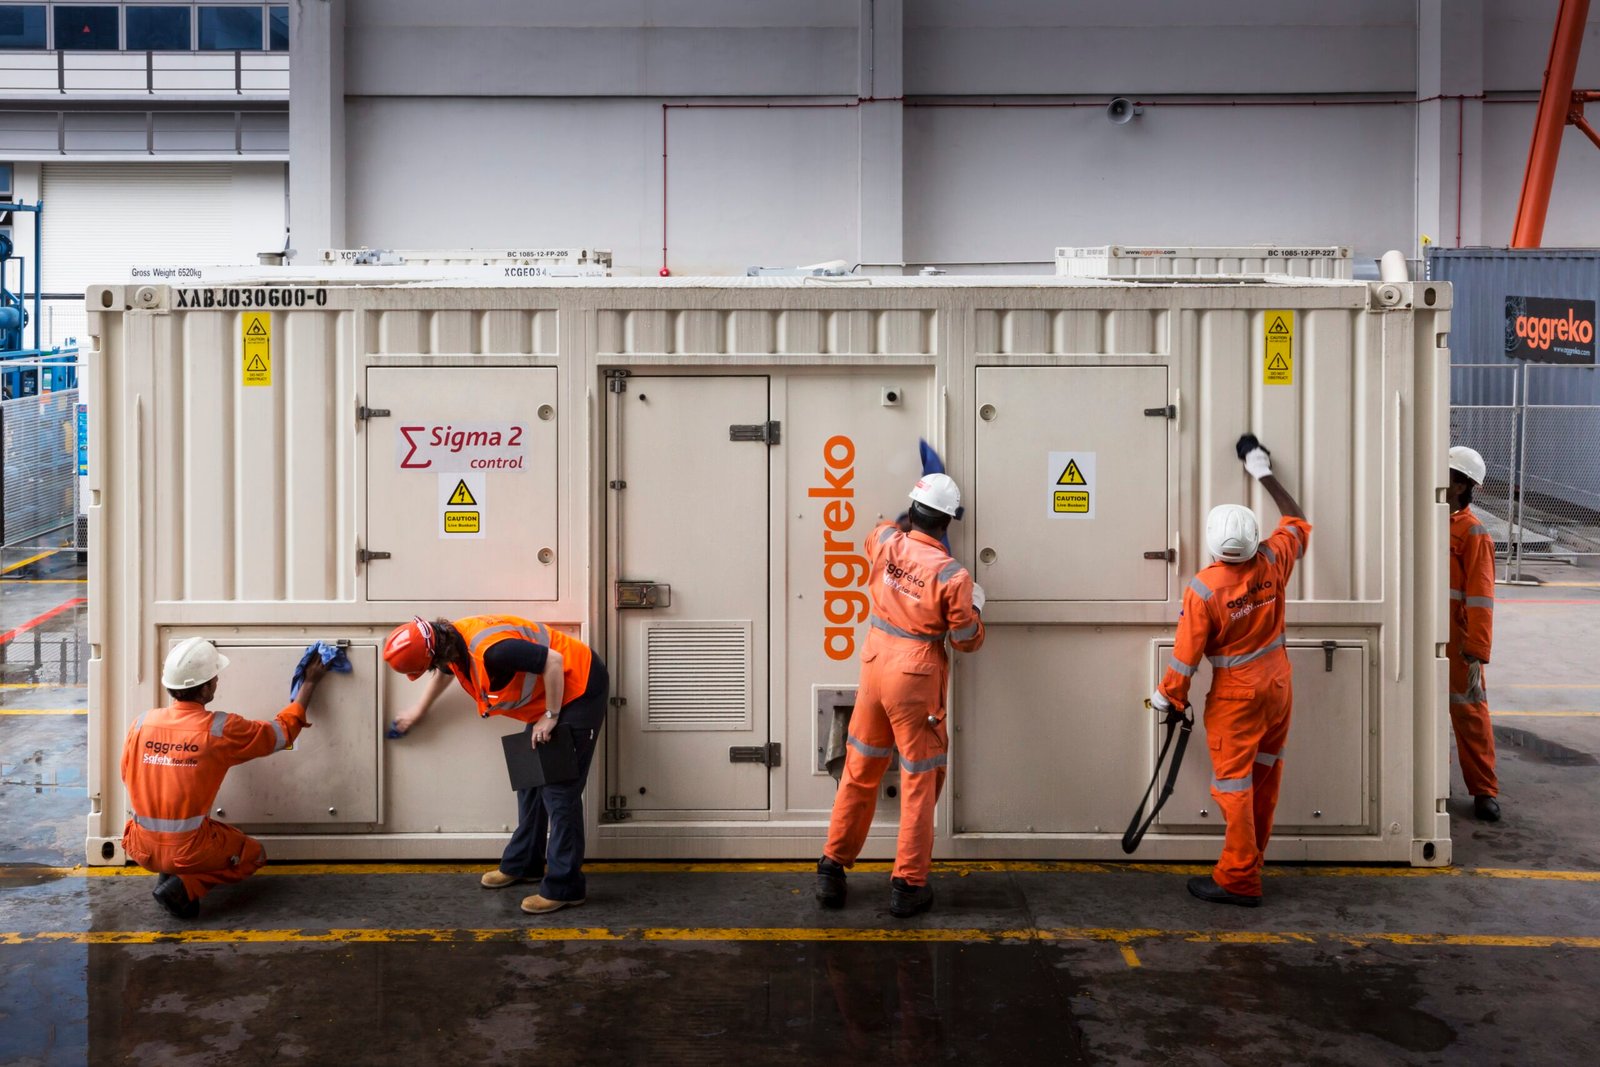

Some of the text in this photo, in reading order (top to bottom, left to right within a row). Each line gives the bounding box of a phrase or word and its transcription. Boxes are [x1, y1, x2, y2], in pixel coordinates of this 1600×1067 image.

[519, 250, 569, 258] 1085-12-FP-205
[1267, 249, 1336, 257] BC 1085-12-FP-227
[131, 268, 202, 279] Gross Weight 6520kg
[176, 288, 328, 308] XABJ030600-0
[1515, 308, 1594, 351] aggreko
[429, 425, 523, 453] Sigma 2
[470, 455, 523, 469] control
[808, 435, 870, 661] aggreko
[1226, 580, 1273, 609] aggeko
[145, 739, 199, 754] aggreko
[143, 753, 172, 765] Safety
